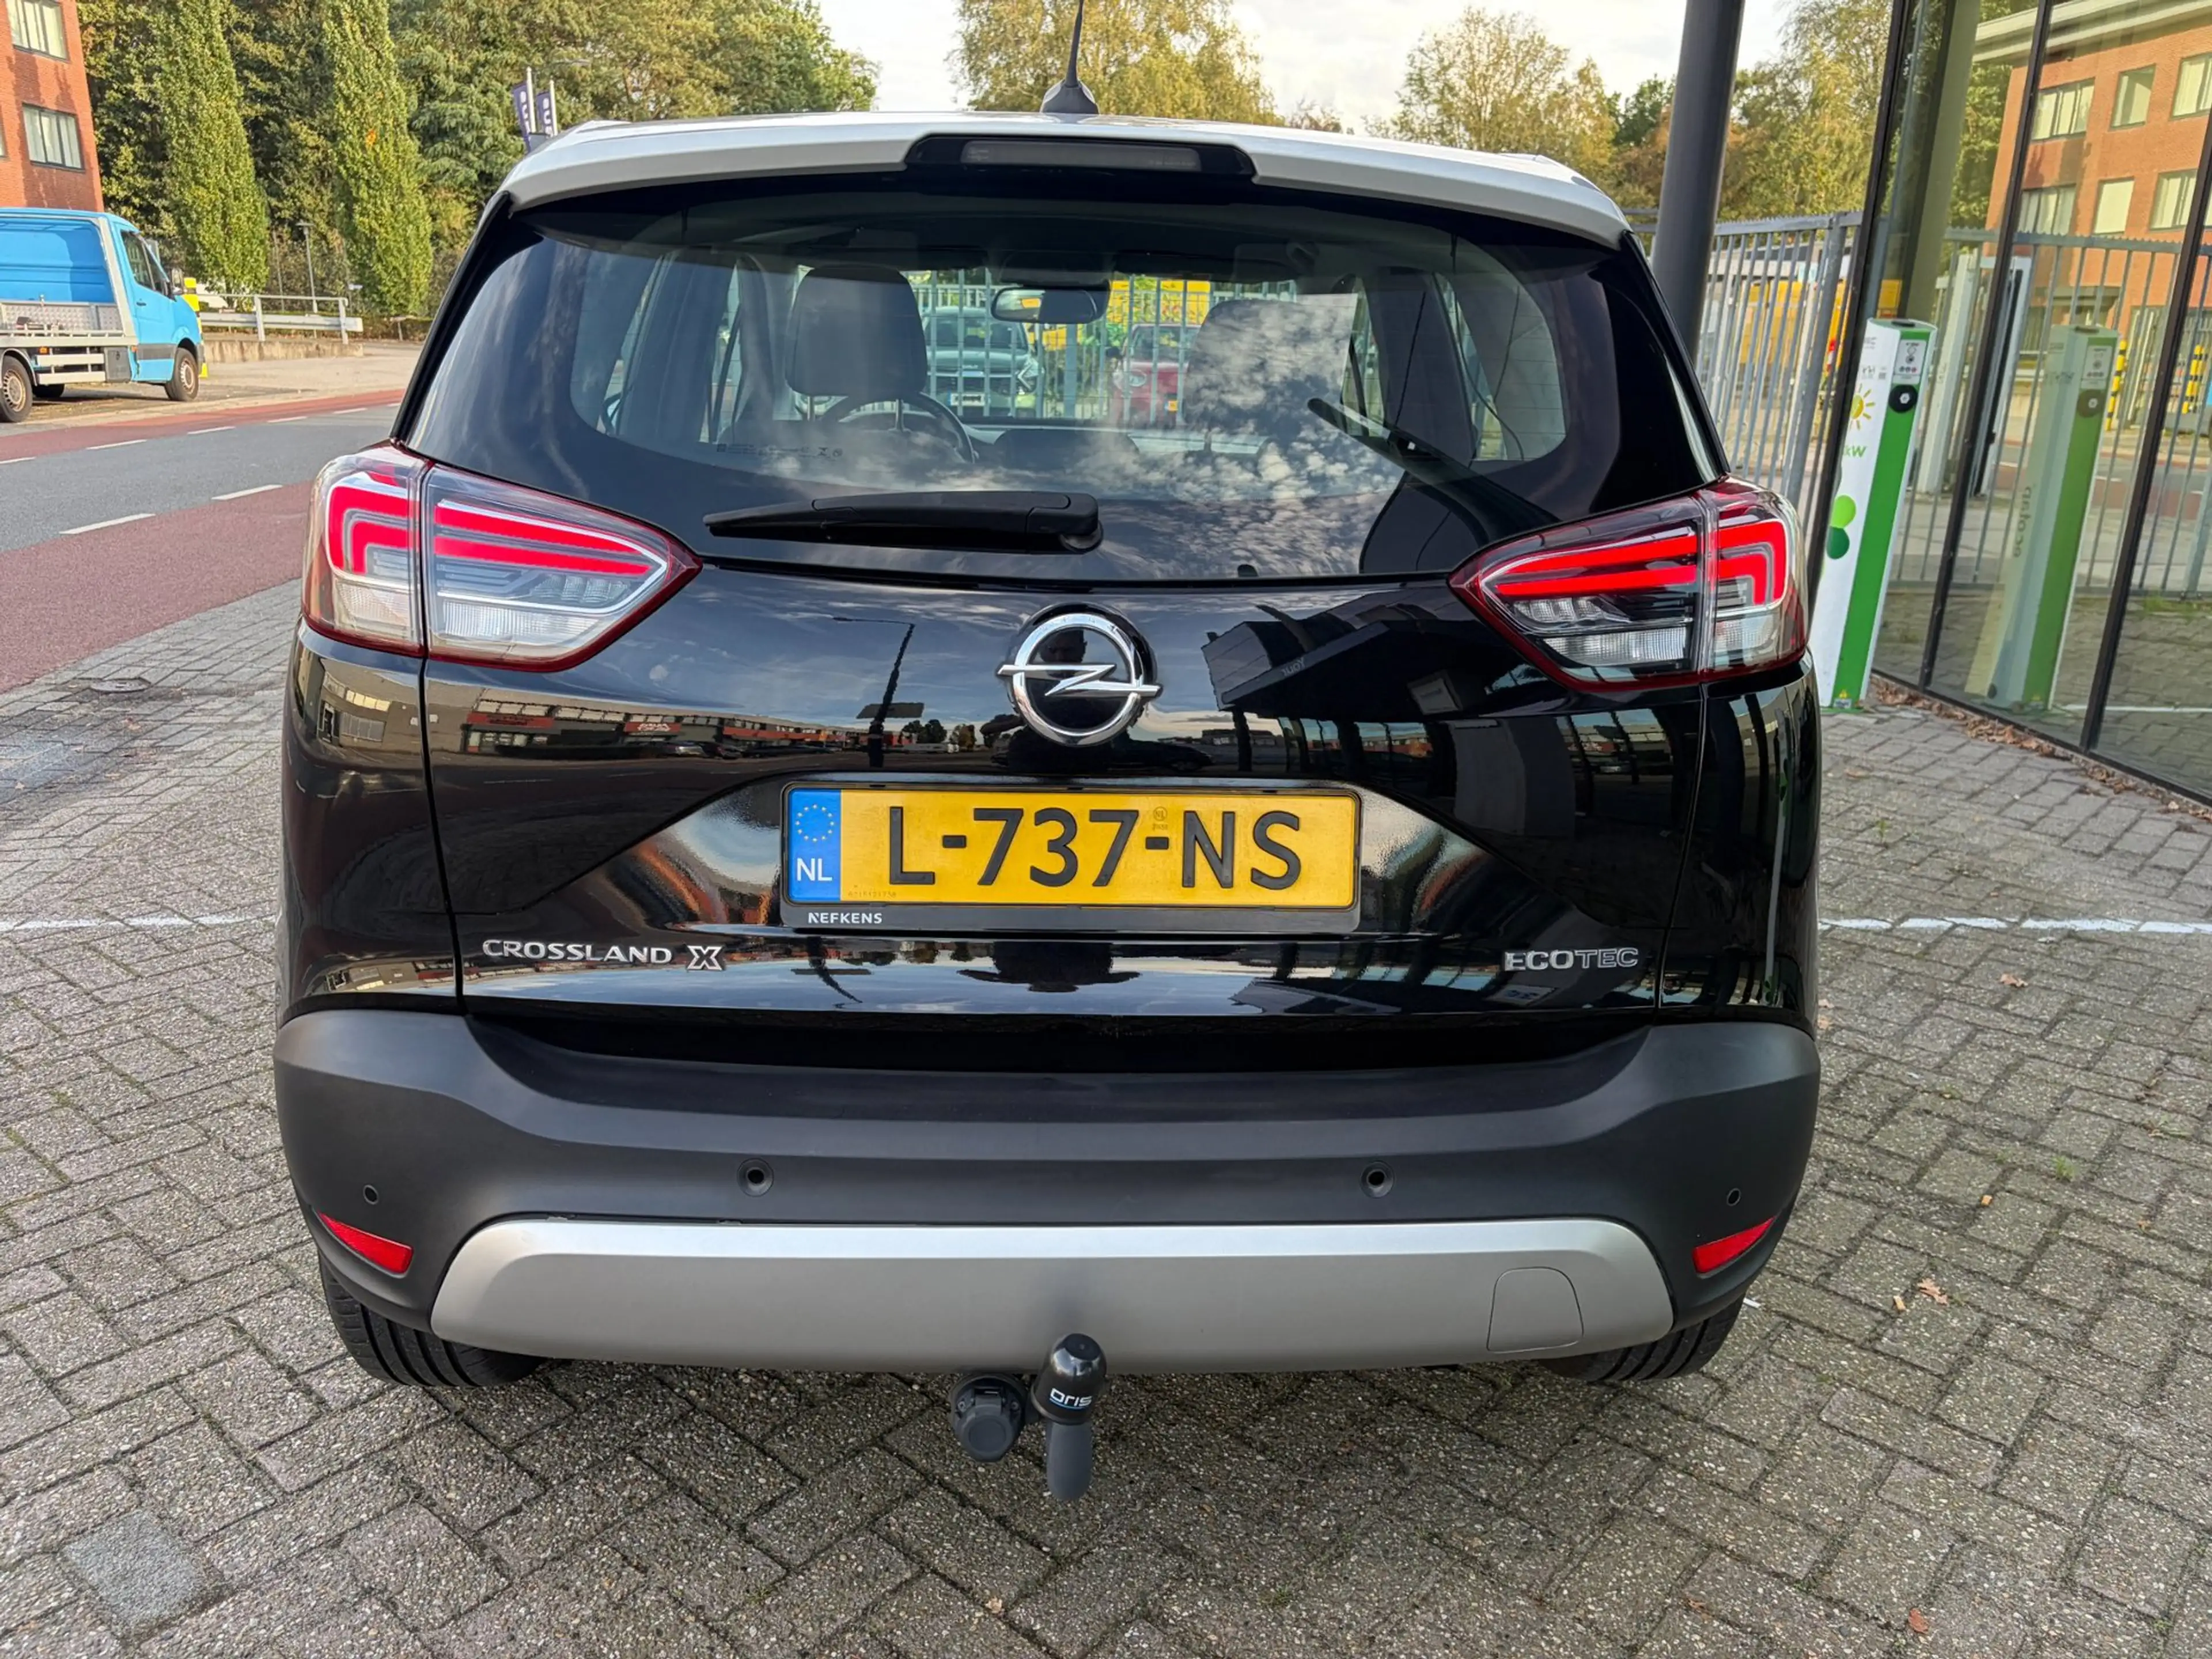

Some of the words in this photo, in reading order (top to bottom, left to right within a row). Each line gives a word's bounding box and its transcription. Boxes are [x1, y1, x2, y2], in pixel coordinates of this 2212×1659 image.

[889, 806, 1302, 890] L-737-NS
[797, 857, 833, 881] NL
[808, 912, 882, 925] NEFKENS
[482, 939, 673, 964] CROSSLAND
[687, 945, 724, 971] X
[1504, 946, 1639, 971] ECOTEC
